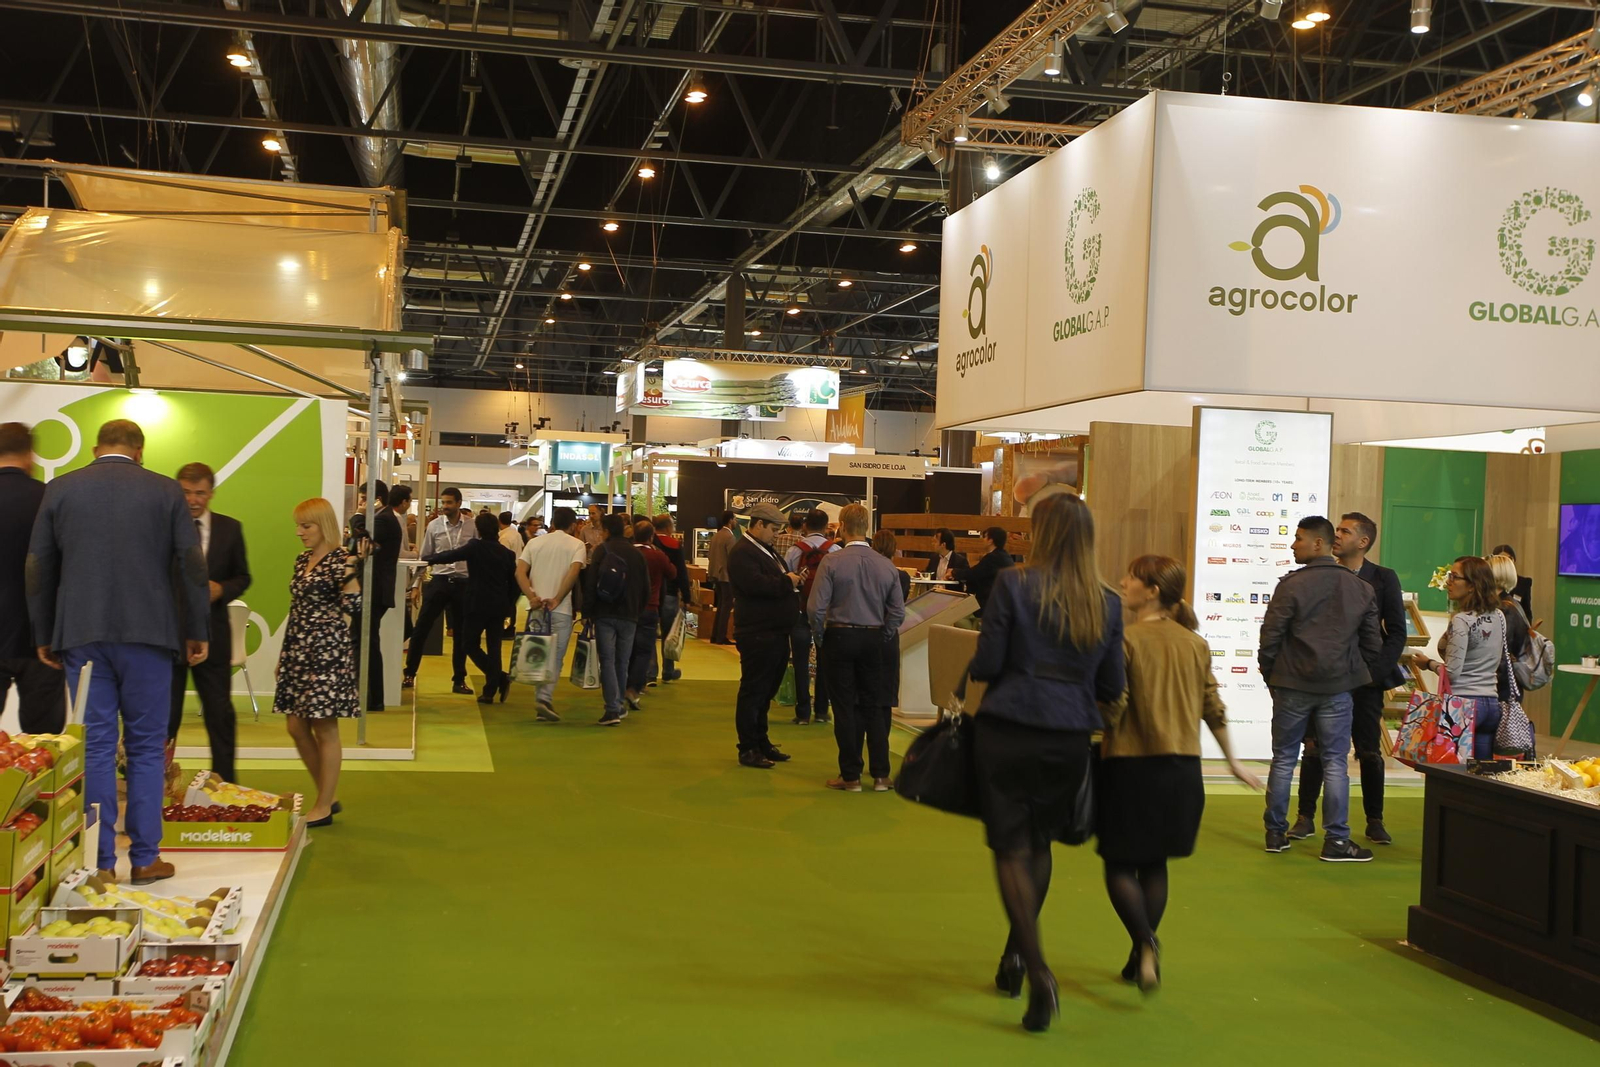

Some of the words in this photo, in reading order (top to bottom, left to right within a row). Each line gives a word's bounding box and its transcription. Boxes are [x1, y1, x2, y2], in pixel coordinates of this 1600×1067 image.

[1208, 285, 1358, 316] agrocolor
[955, 337, 997, 378] agrocolor
[641, 394, 673, 405] esurca
[560, 453, 600, 461] INDASOL
[1256, 510, 1275, 518] coop
